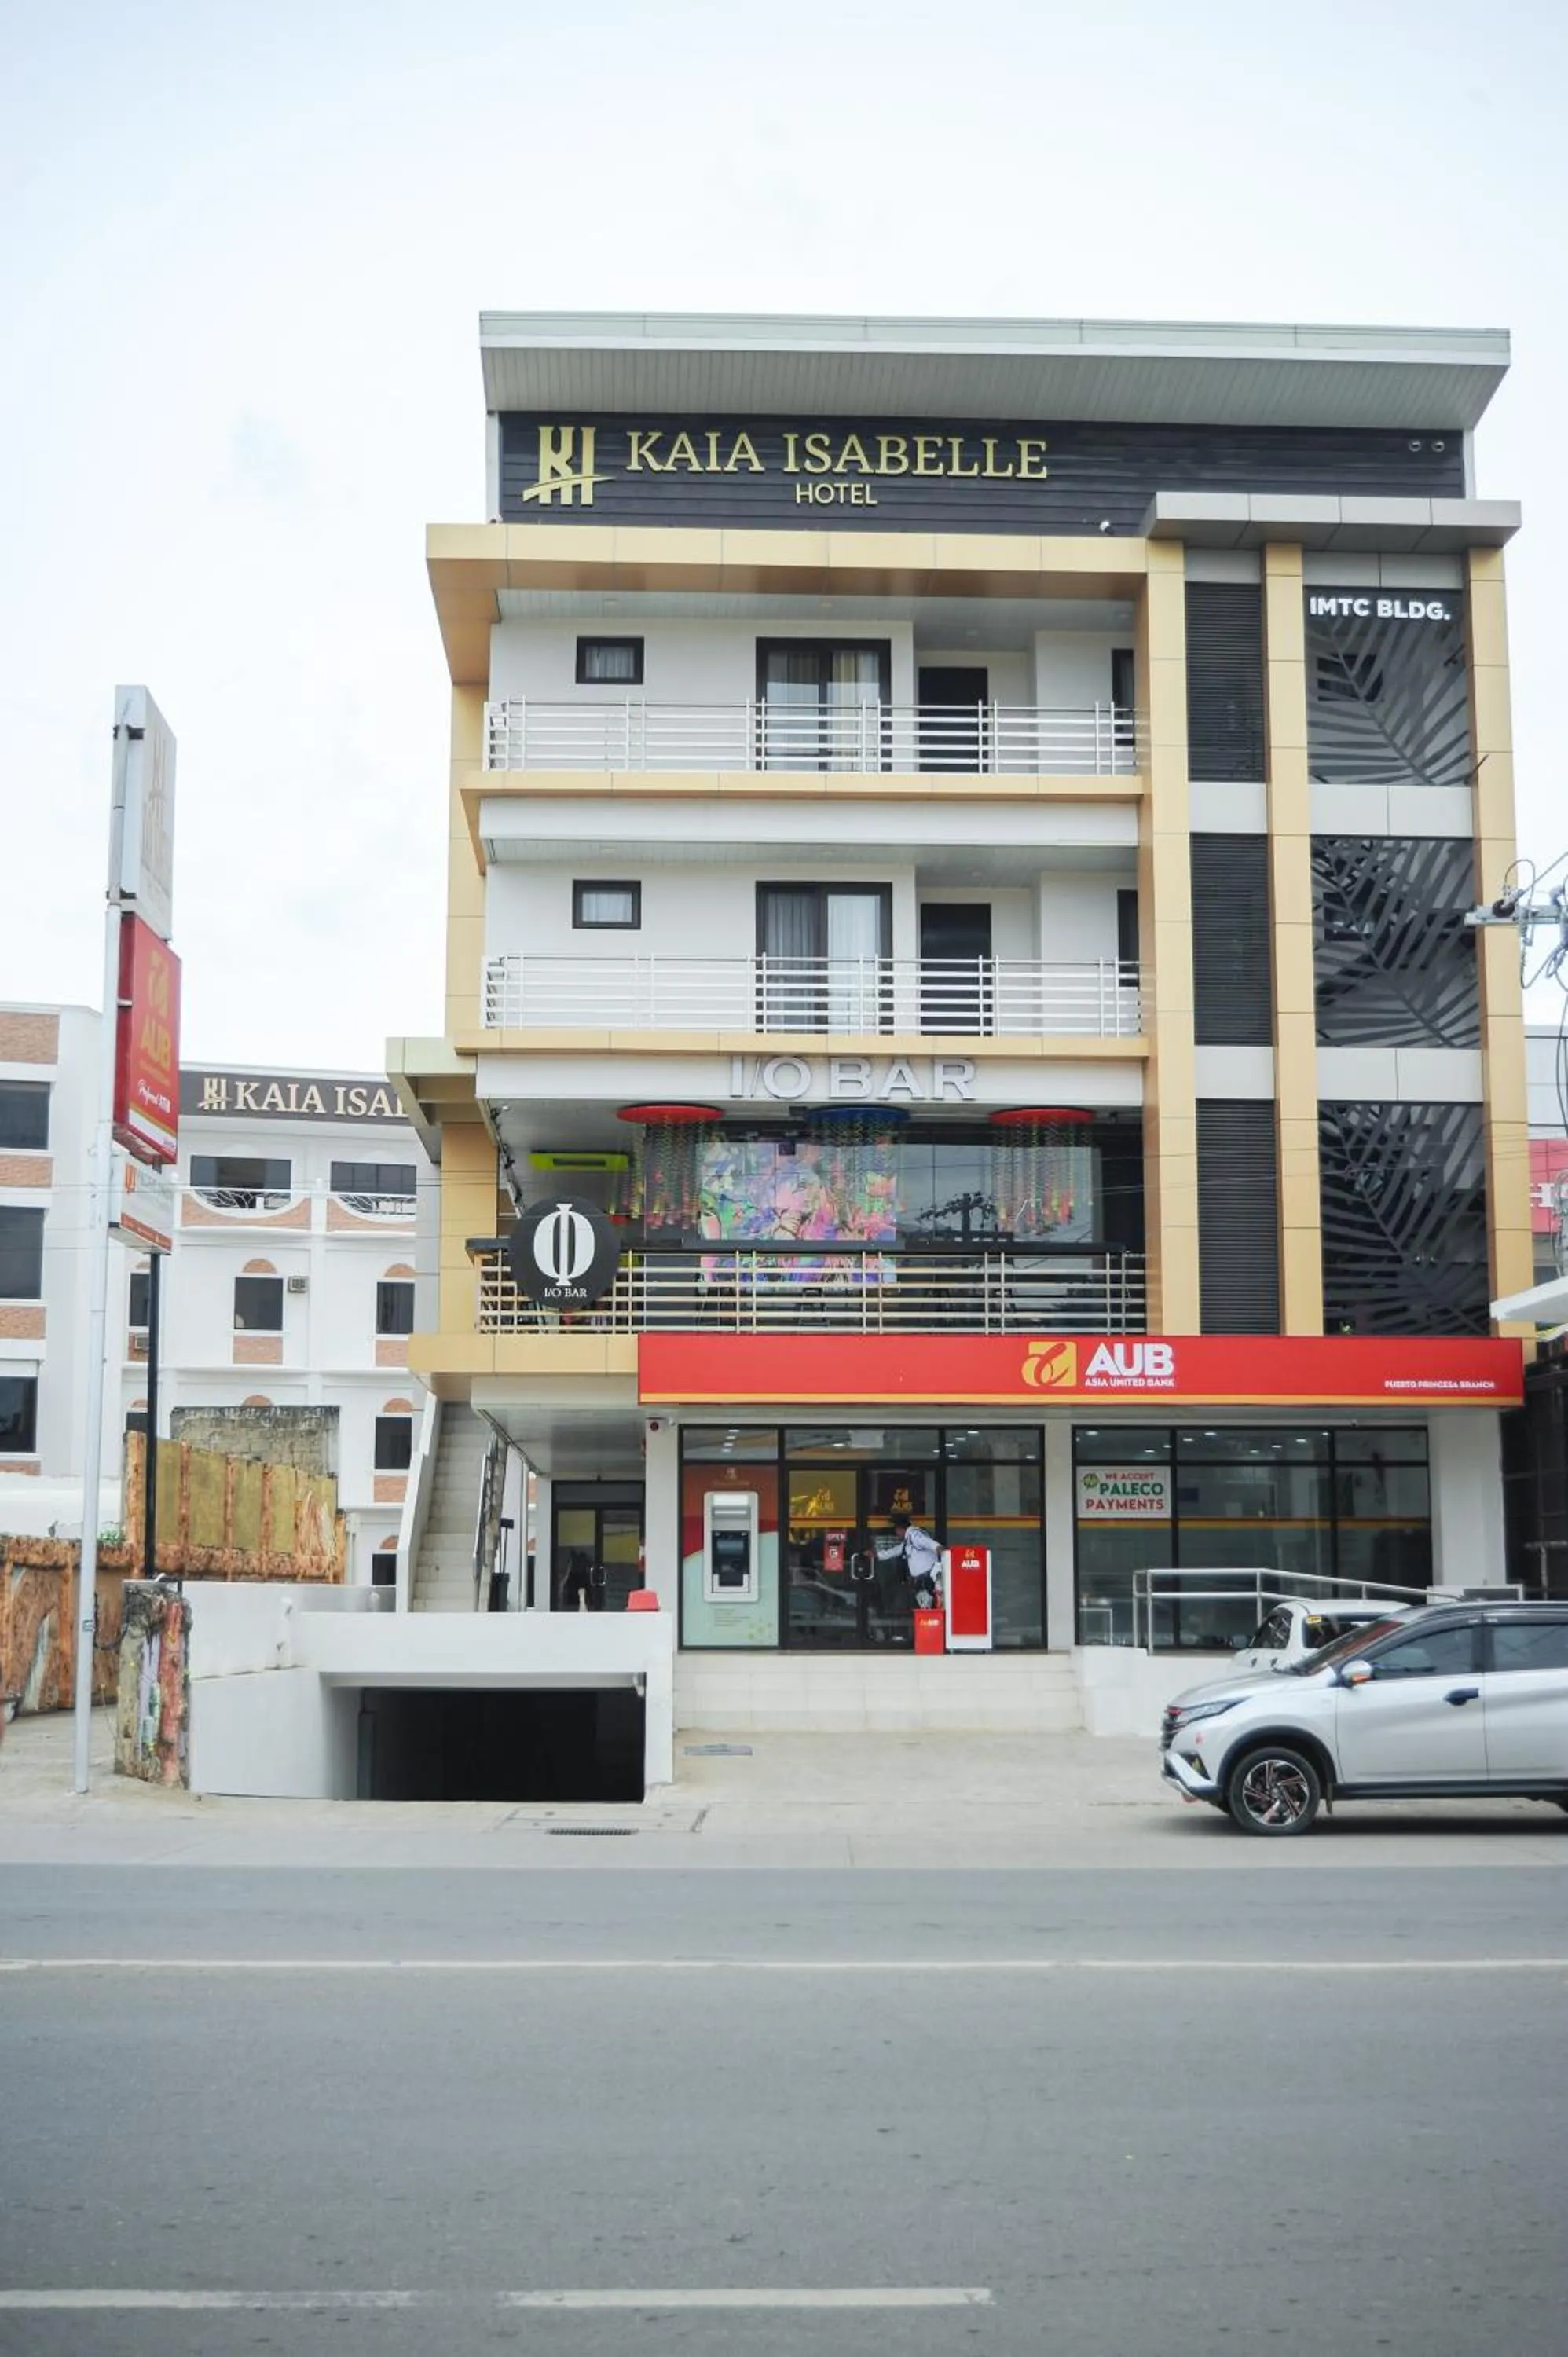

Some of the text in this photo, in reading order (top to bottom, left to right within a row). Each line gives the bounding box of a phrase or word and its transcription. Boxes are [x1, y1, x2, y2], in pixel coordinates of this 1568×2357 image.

[626, 431, 1048, 480] KAIA ISABELLE
[795, 483, 878, 505] HOTEL
[1310, 596, 1452, 621] IMTC BLDG.
[730, 1056, 977, 1101] I/O BAR
[233, 1080, 327, 1113] KAIA
[544, 1288, 588, 1298] I/O BAR
[1084, 1342, 1174, 1376] AUB
[1085, 1377, 1174, 1387] ASIA UNITED BANK
[1384, 1380, 1495, 1389] PUERTO PRINCESA BRANCH
[1100, 1482, 1164, 1496] PALECO
[1086, 1498, 1164, 1509] PAYMENTS
[961, 1560, 980, 1568] AUB
